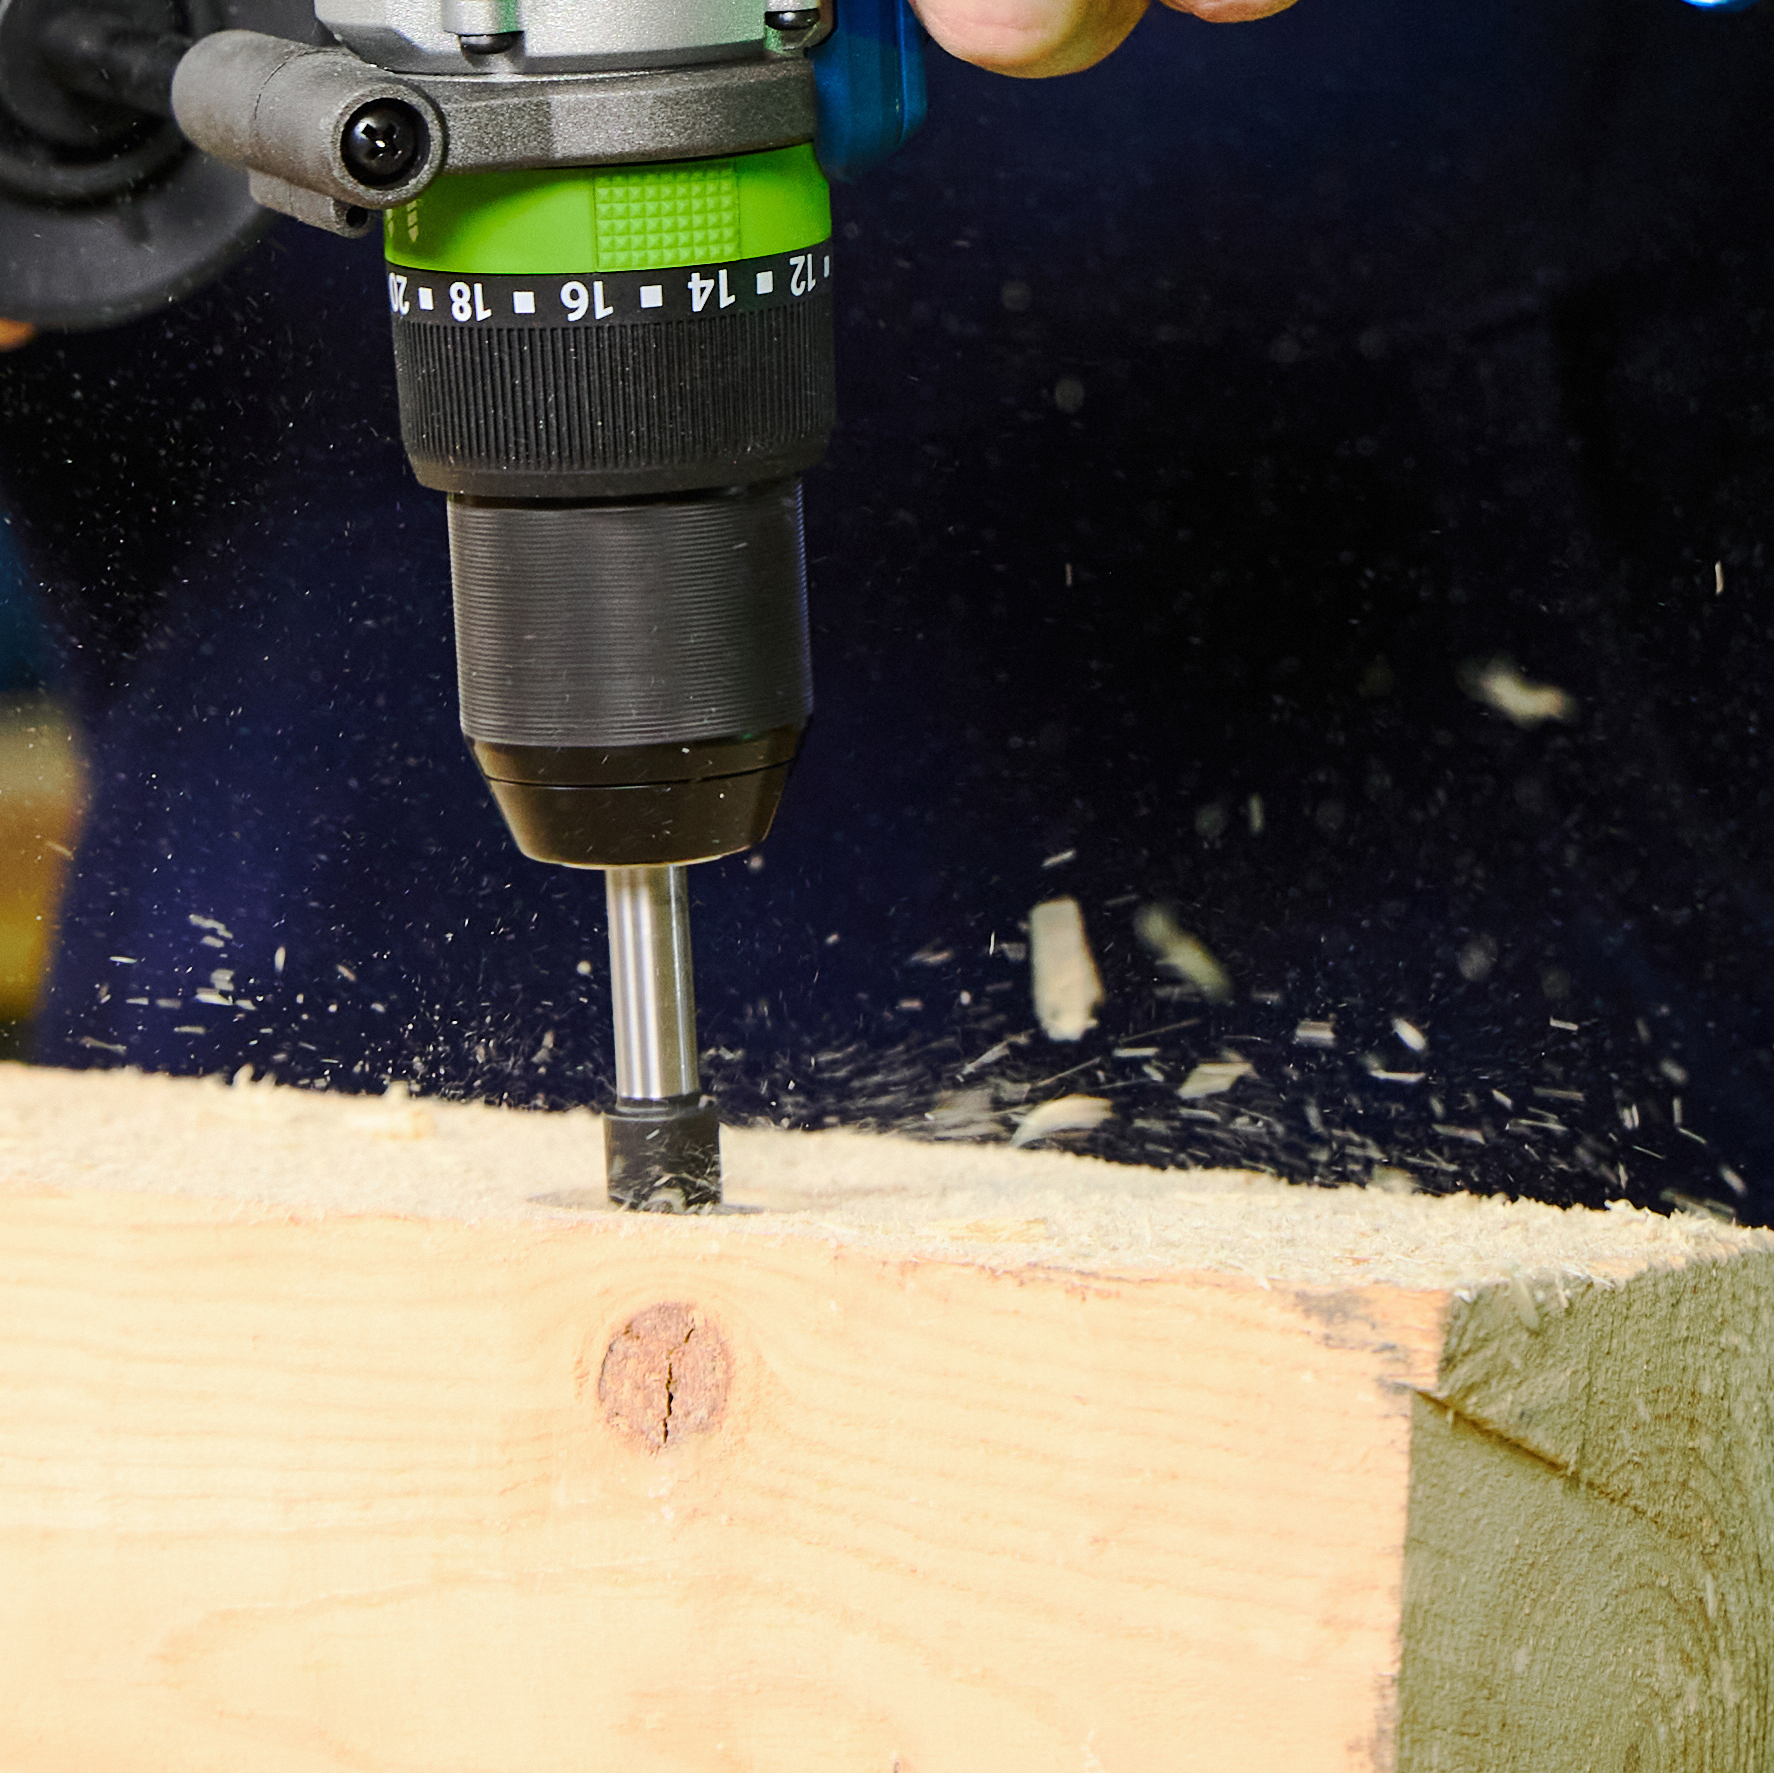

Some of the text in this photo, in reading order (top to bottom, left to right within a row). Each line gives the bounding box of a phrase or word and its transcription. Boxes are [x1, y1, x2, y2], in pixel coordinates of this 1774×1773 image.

[686, 269, 737, 313] 14
[788, 253, 817, 297] 12
[448, 280, 493, 323] 18
[559, 279, 615, 322] 16
